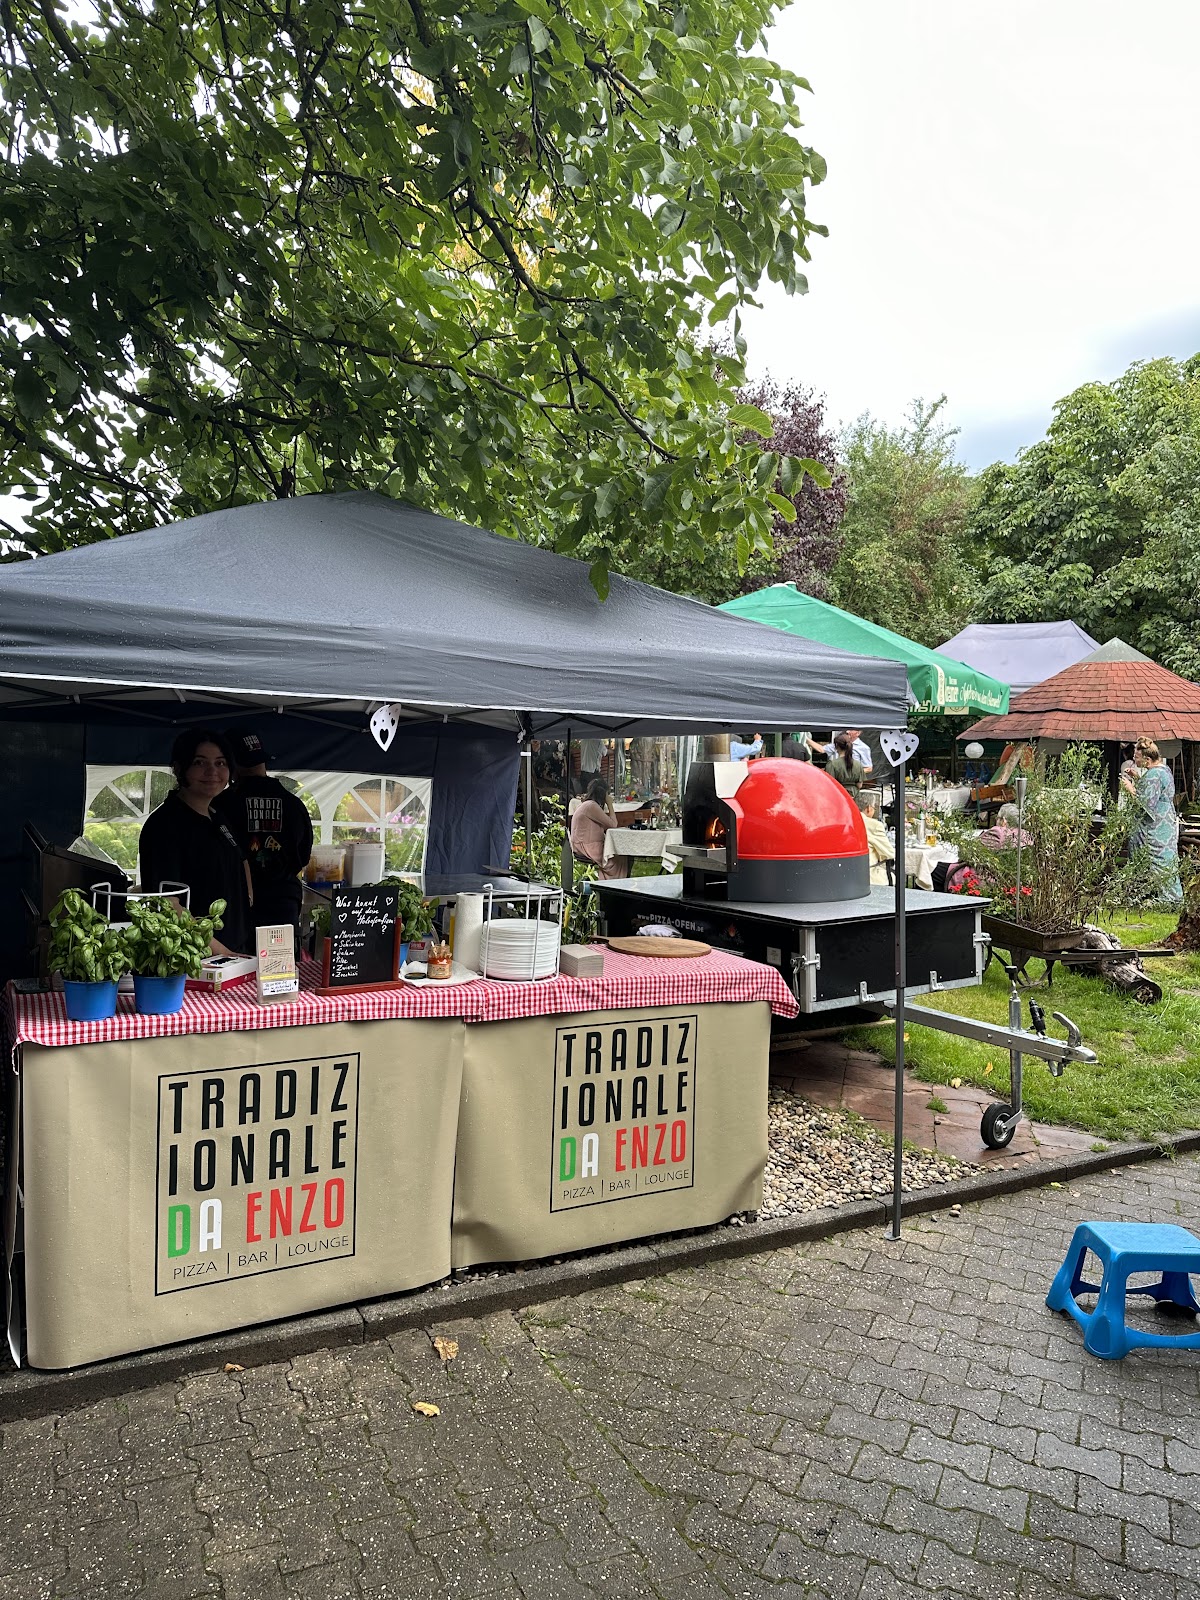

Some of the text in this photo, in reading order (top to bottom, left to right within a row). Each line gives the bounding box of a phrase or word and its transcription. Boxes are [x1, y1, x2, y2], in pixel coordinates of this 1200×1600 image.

[248, 799, 280, 809] TRADIZ
[249, 809, 280, 820] IONALE
[335, 895, 352, 908] Was
[351, 908, 364, 917] auf
[338, 939, 365, 948] Schinken
[562, 1022, 690, 1078] TRADIZ
[168, 1062, 350, 1135] TRADIZ
[561, 1071, 688, 1130] IONALE
[168, 1119, 347, 1197] IONALE
[559, 1119, 686, 1182] DA ENZO
[563, 1169, 690, 1200] PIZZA BAR LOUNGE
[167, 1177, 345, 1259] DA ENZO
[173, 1235, 350, 1280] PIZZA BAR LOUNGE
